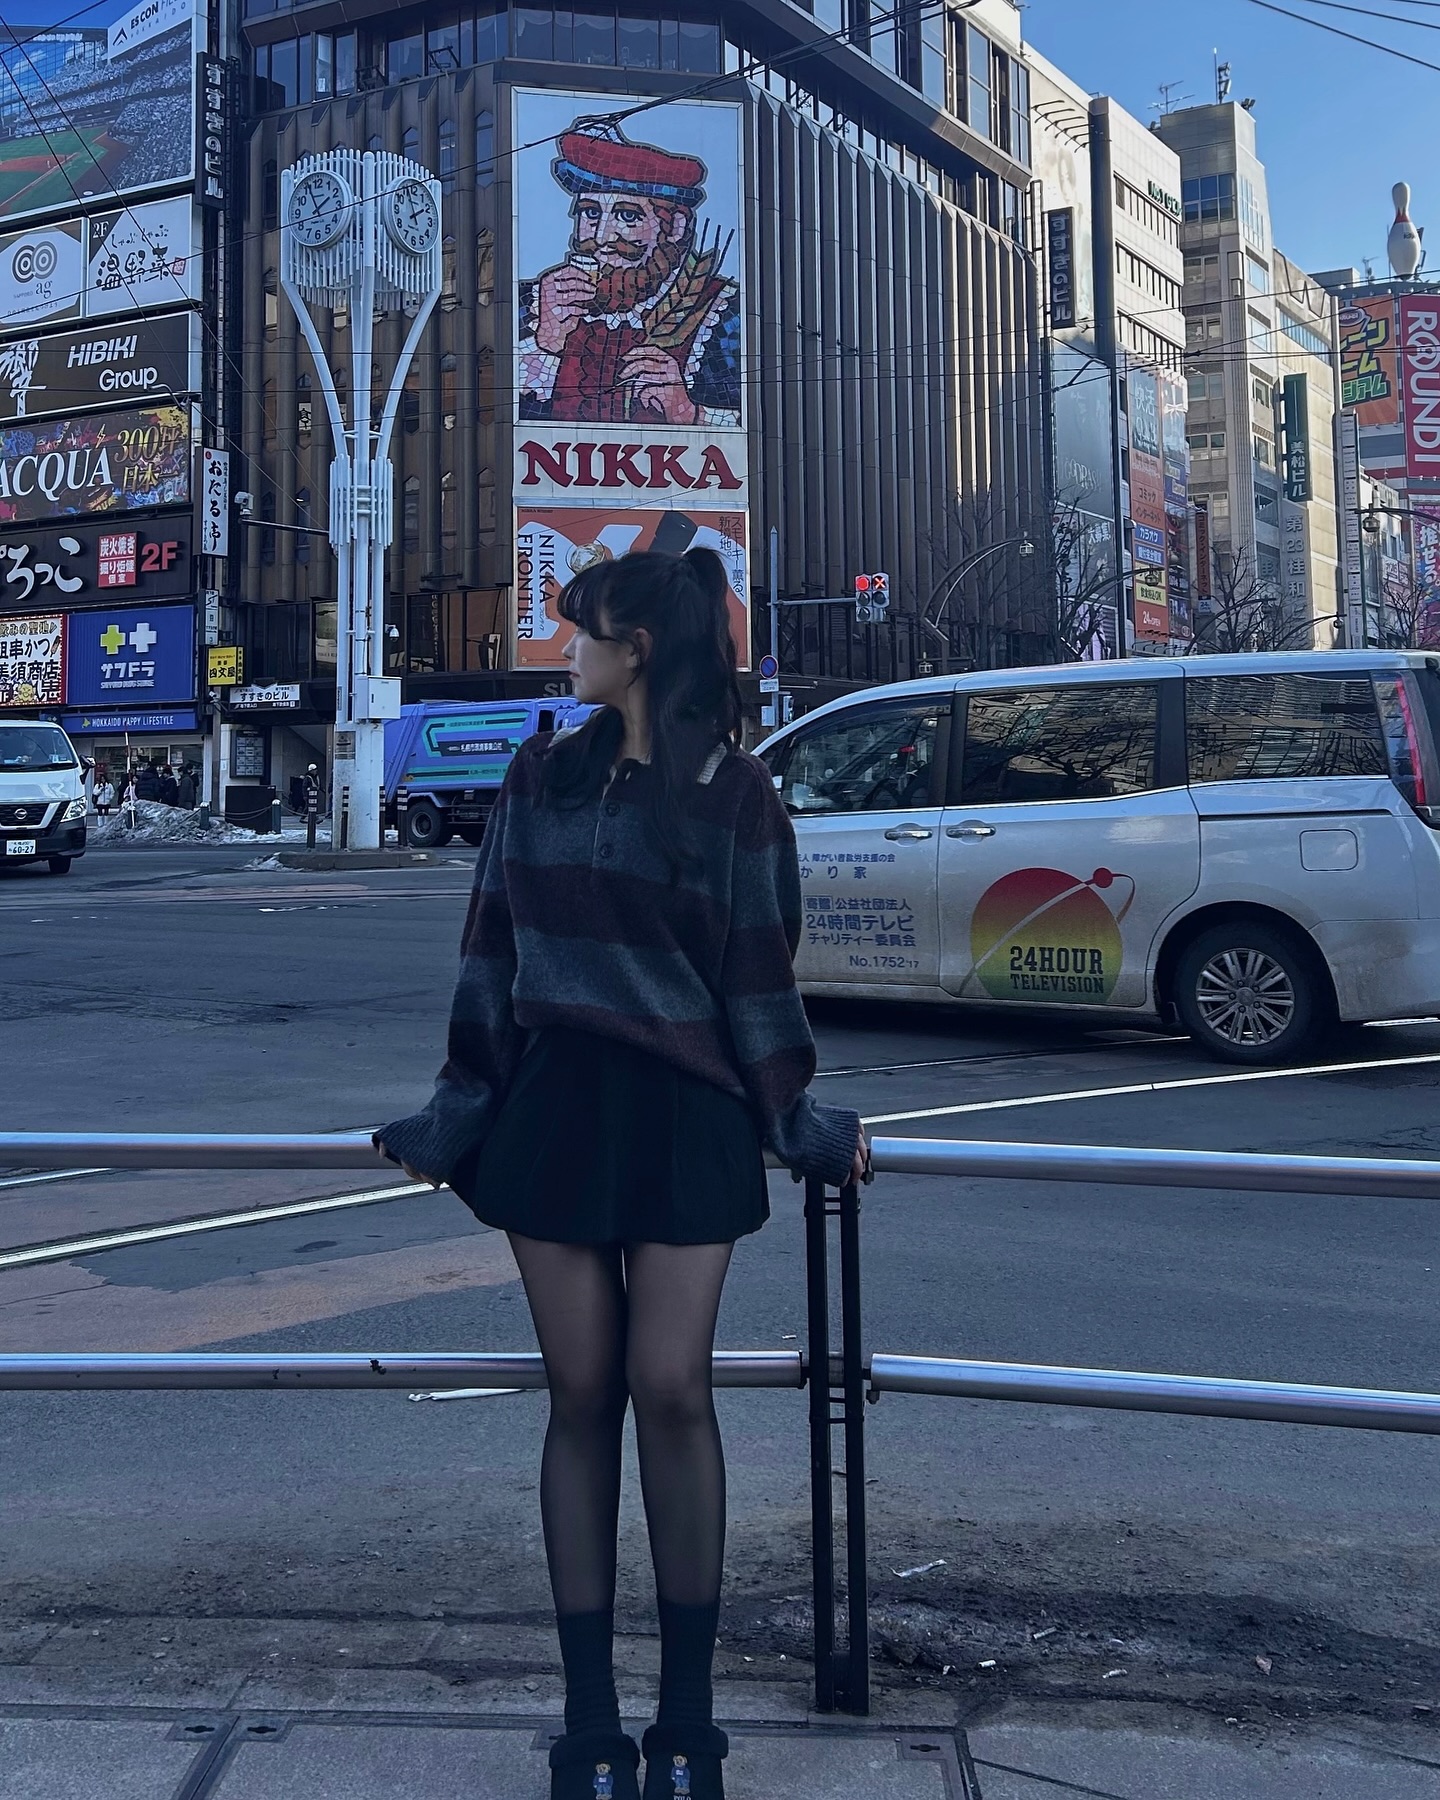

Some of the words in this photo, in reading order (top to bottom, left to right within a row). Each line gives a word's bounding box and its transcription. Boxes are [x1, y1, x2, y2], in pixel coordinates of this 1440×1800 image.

[131, 2, 159, 29] ESCON
[92, 221, 109, 239] 2F
[1051, 213, 1072, 322] すすきのビル
[35, 280, 53, 299] ag
[67, 335, 138, 368] HIBIKI
[99, 367, 158, 392] Group
[518, 440, 743, 489] NIKKA
[1138, 487, 1156, 503] コミック
[1140, 526, 1158, 543] カラオケ
[100, 535, 136, 557] 炭火焼き
[141, 541, 178, 572] 2F
[0, 536, 83, 600] ろっこ
[108, 573, 126, 584] 個室
[538, 534, 555, 603] NIKKA
[517, 534, 533, 640] FRONTIER
[240, 691, 289, 702] すすきのビル
[92, 718, 121, 727] HOKKAIDO
[143, 715, 174, 726] LIFESTYLE
[835, 898, 912, 911] 公益社団法人
[806, 914, 914, 931] 24時間テレビ
[808, 933, 916, 947] チャリティー委員会
[1010, 945, 1103, 975] 24HOUR
[1010, 973, 1105, 993] TELEVISION
